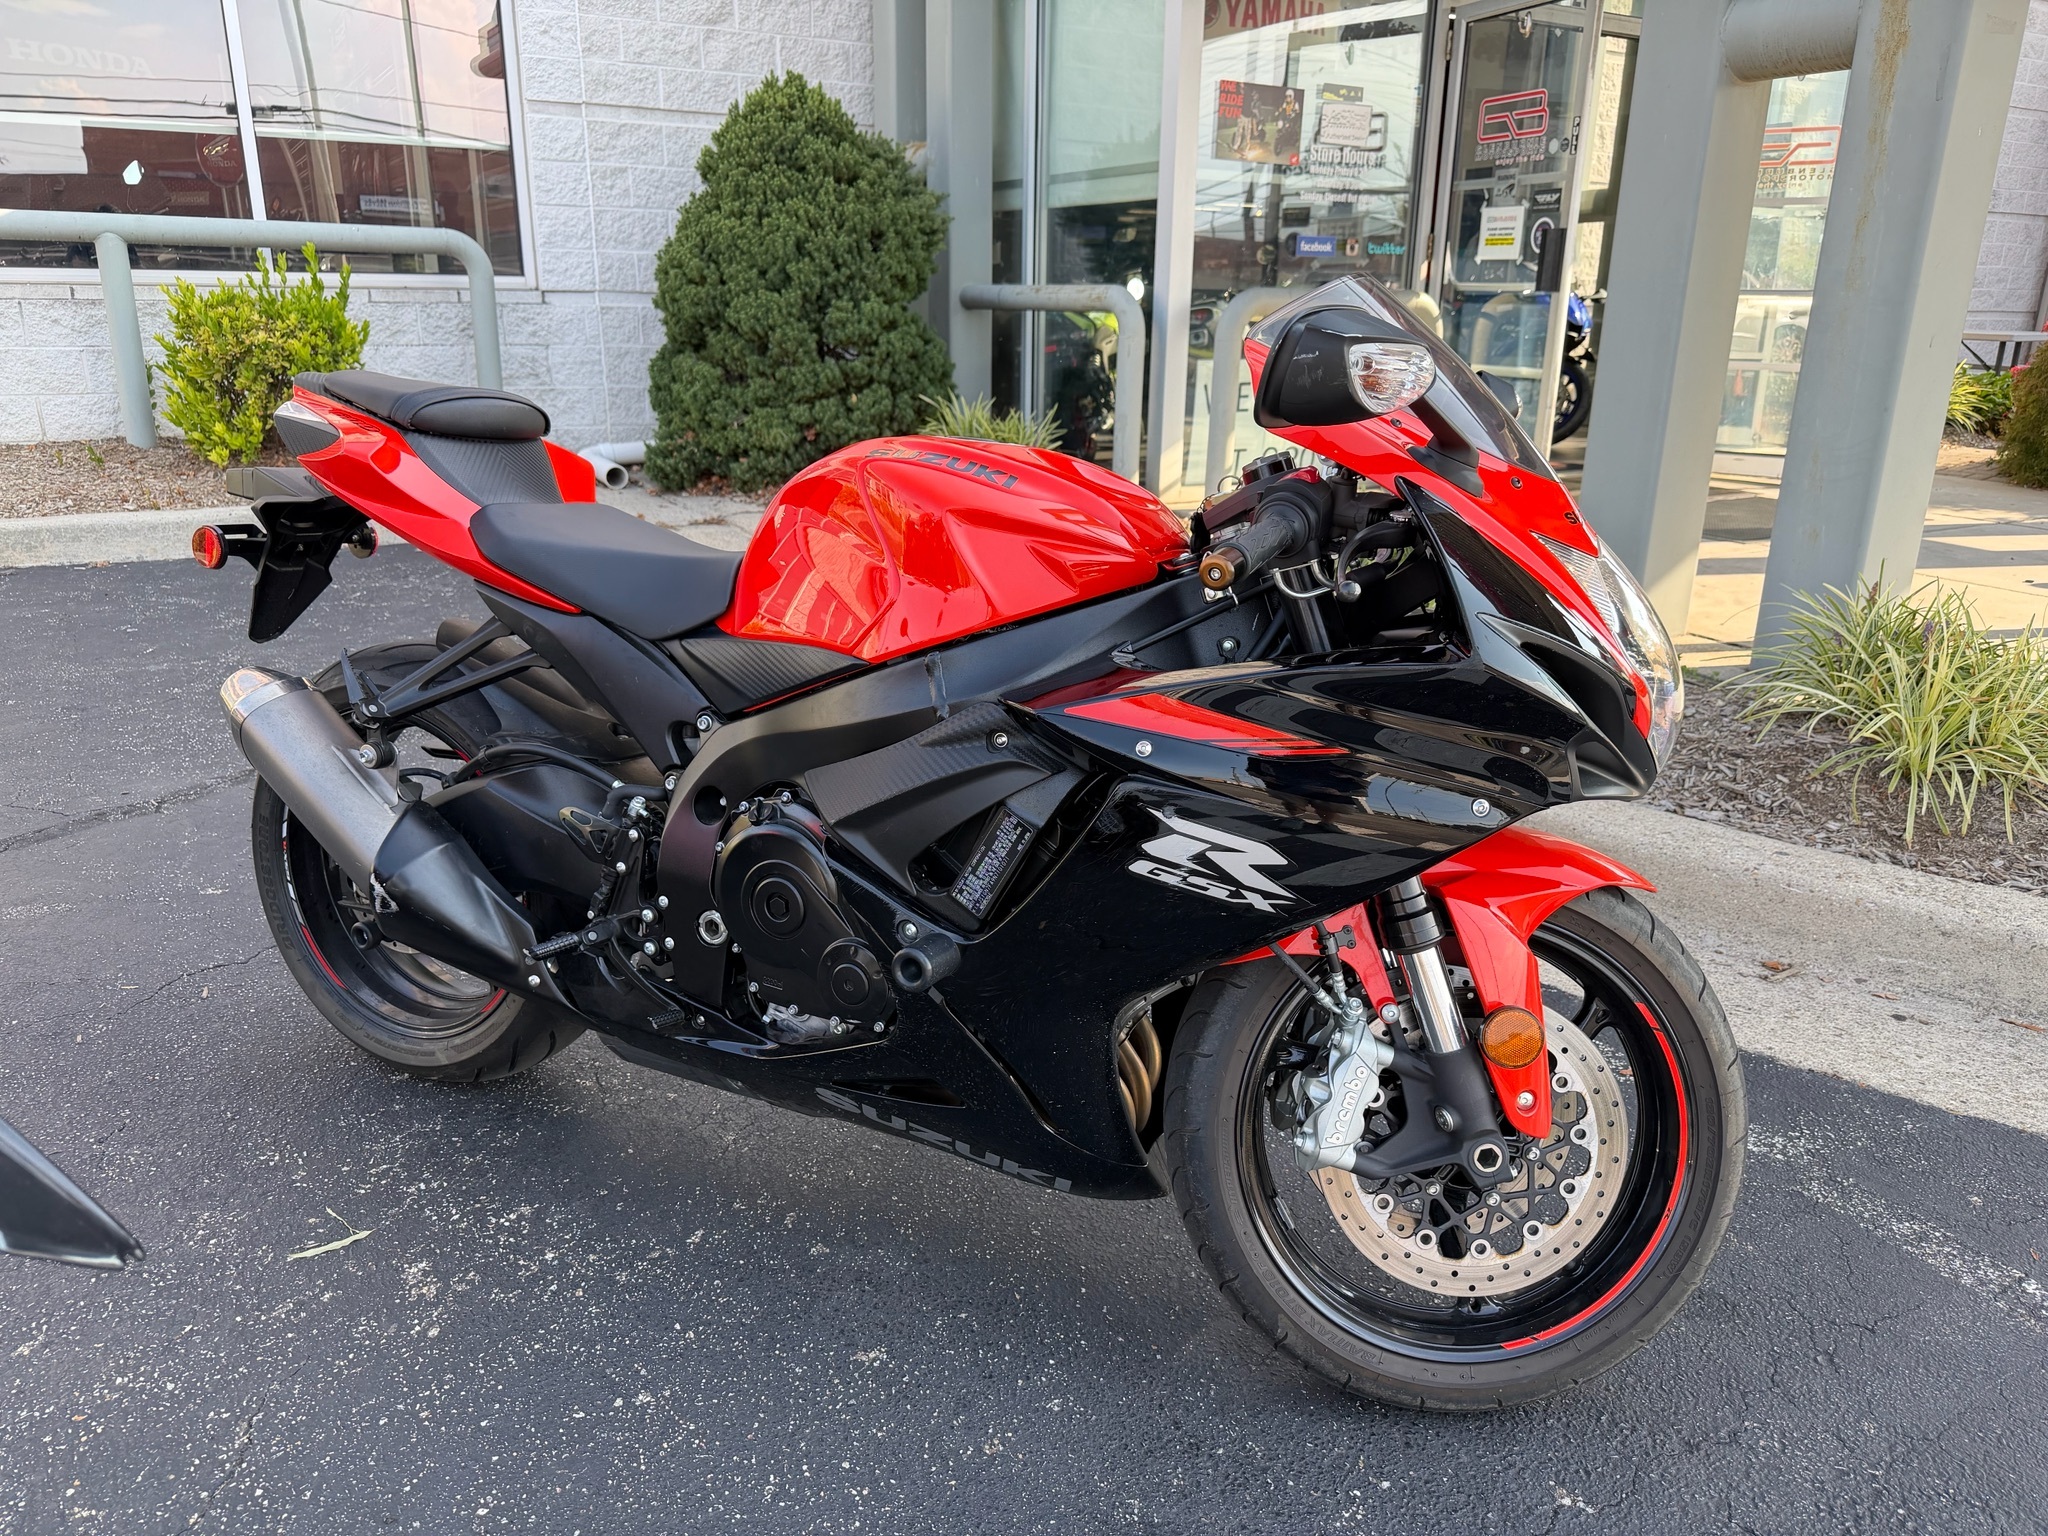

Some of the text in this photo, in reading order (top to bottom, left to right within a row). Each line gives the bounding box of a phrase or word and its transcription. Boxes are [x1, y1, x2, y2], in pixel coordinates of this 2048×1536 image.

[4, 36, 153, 76] HONDA
[1218, 106, 1242, 118] FUN
[1219, 93, 1244, 107] RIDE
[1310, 145, 1377, 165] Store Hours
[1570, 116, 1580, 154] PULL
[1300, 240, 1406, 255] facebook twitter
[865, 448, 1019, 490] SUZUKI
[256, 813, 295, 949] BRIDGESTONE
[1325, 1066, 1368, 1144] brembo
[815, 1087, 1072, 1192] SUZUKI
[1304, 1314, 1376, 1361] BATTLAX
